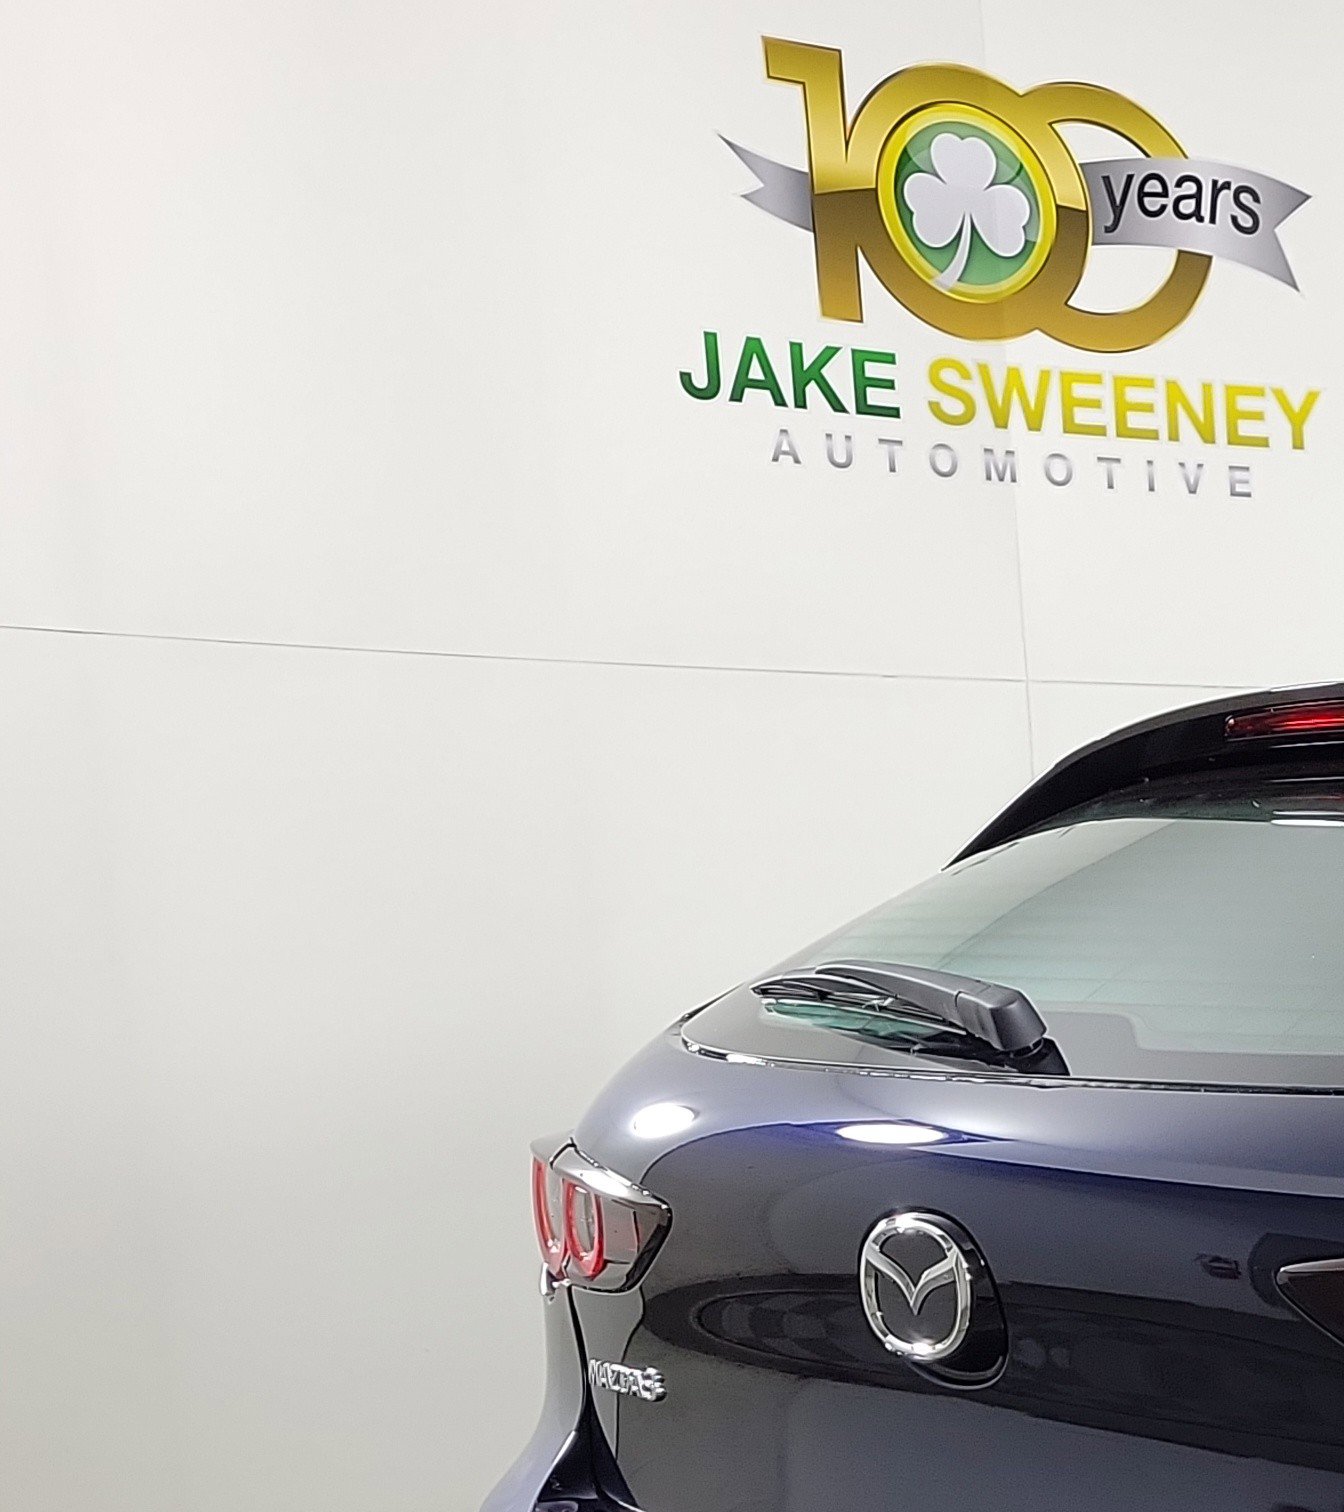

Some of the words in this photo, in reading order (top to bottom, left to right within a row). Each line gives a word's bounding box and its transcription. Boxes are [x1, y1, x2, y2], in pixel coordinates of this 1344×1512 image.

[761, 36, 1212, 353] 100
[1103, 172, 1260, 234] years
[679, 331, 902, 419] JAKE
[927, 358, 1321, 450] SWEENEY
[771, 429, 1253, 498] AUTOMOTIVE
